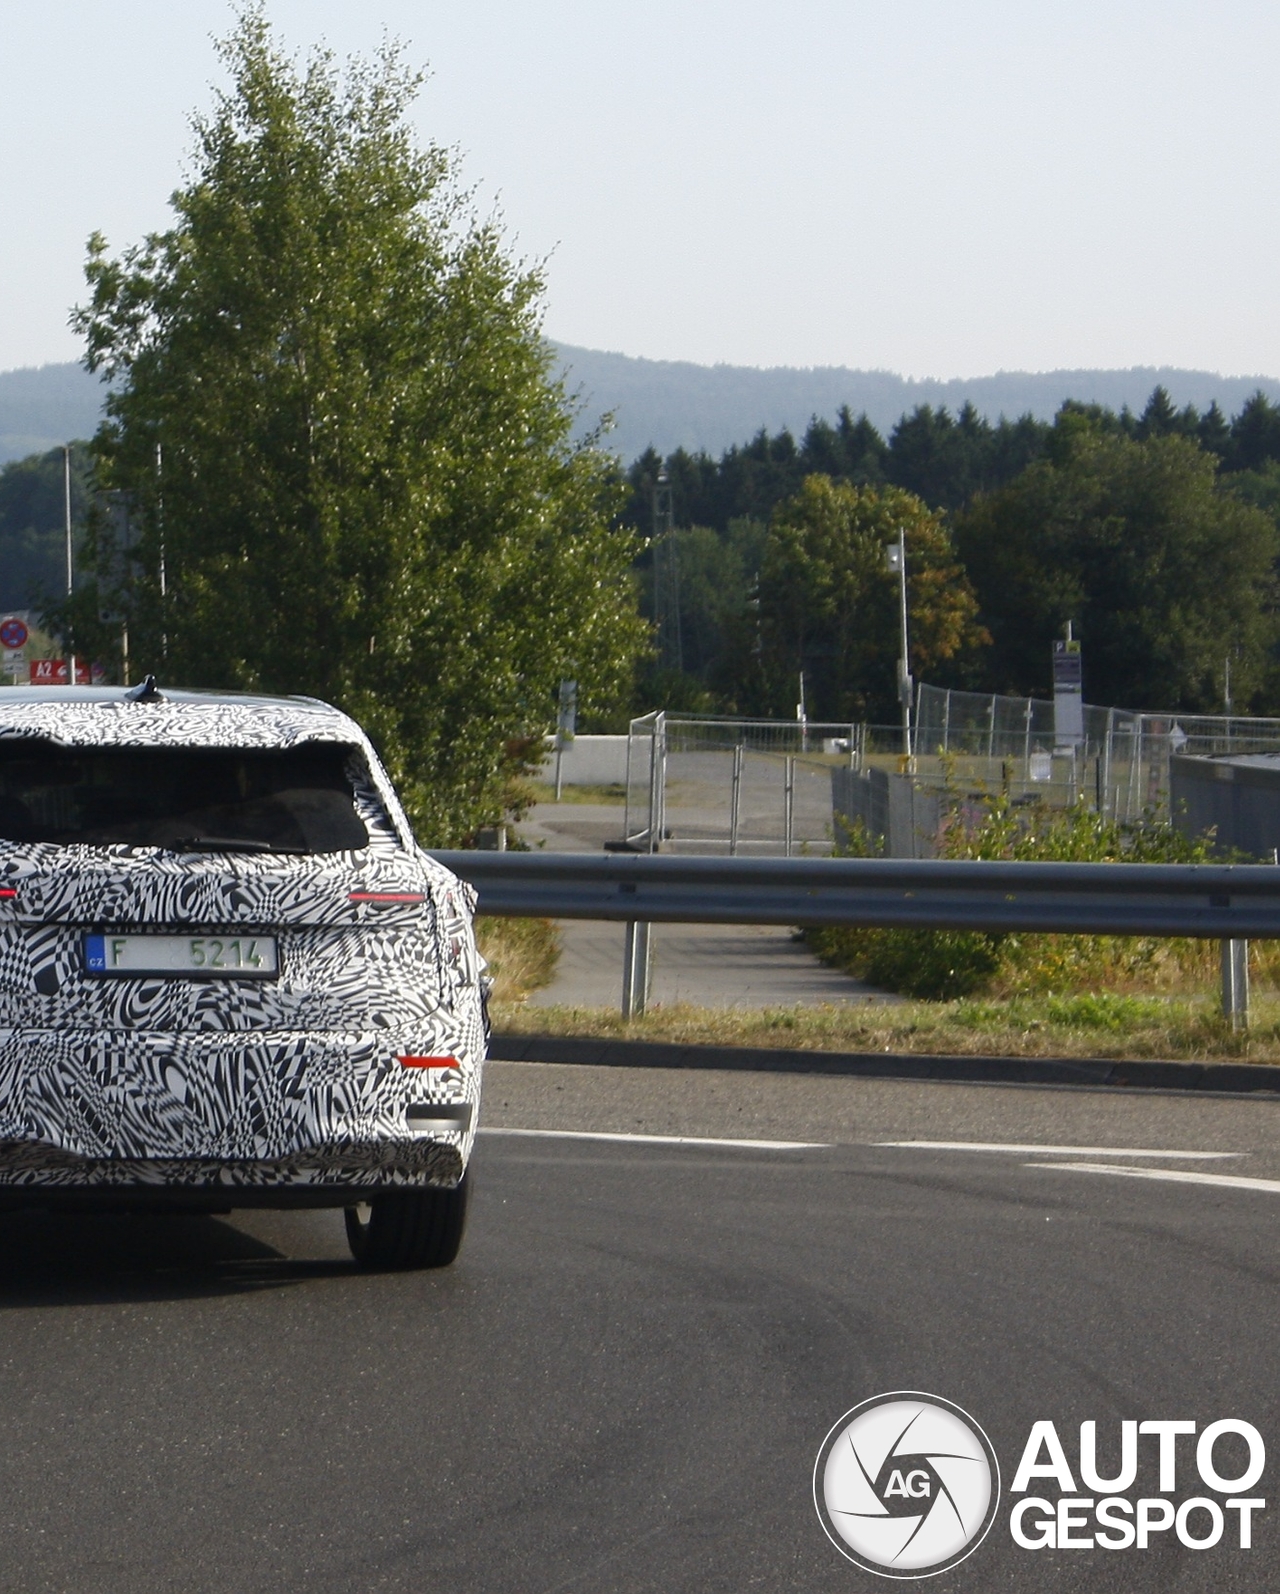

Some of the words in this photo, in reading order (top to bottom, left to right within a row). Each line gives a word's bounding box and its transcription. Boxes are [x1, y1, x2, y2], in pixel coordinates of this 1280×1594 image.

[36, 661, 52, 677] A2
[111, 939, 127, 966] F
[190, 939, 264, 968] 5214
[89, 959, 104, 967] CZ
